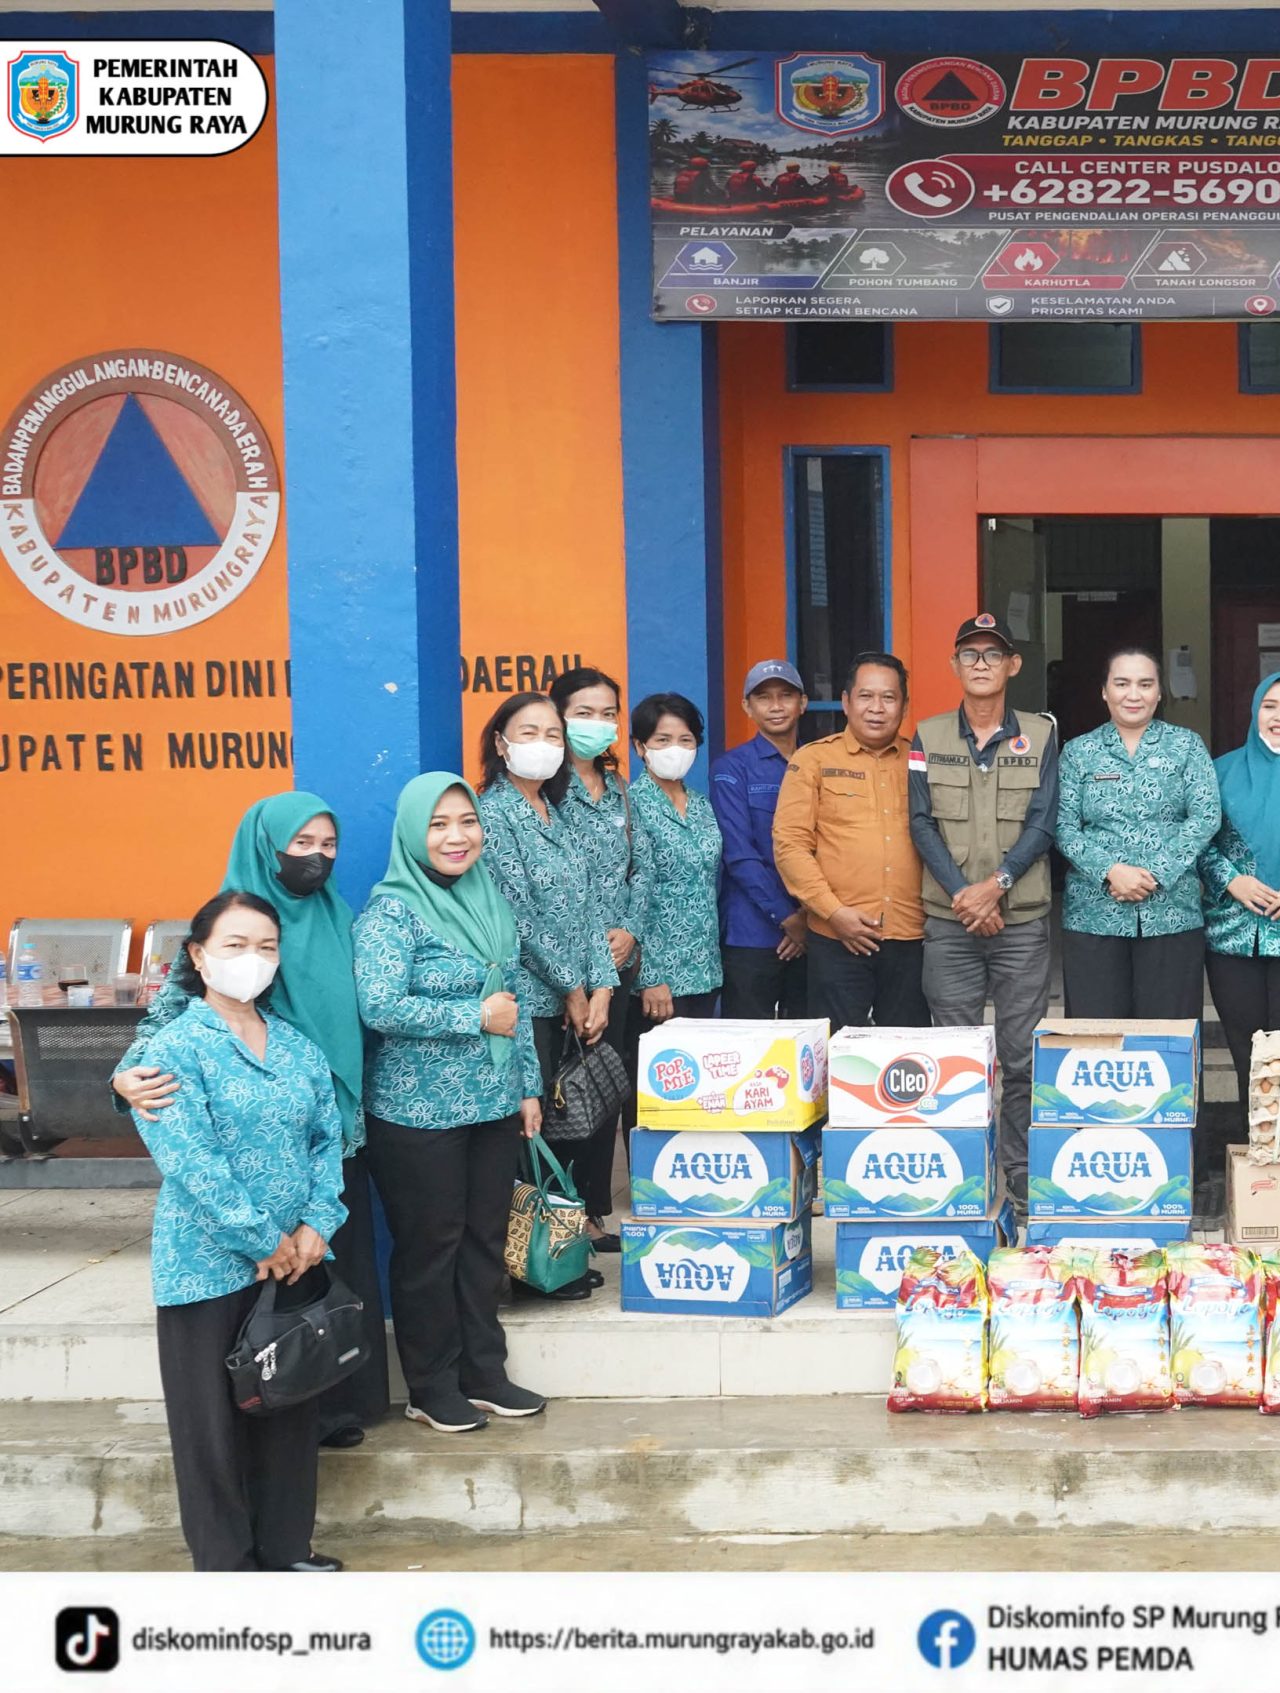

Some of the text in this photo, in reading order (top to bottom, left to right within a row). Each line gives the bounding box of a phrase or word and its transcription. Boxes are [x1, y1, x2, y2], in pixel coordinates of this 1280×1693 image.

[1007, 115, 1150, 130] KABUPATEN
[1155, 115, 1259, 130] MURUNG
[1001, 134, 1093, 147] TANGGAP
[1113, 134, 1204, 147] TANGKAS
[1014, 160, 1074, 175] CALL
[1080, 160, 1170, 175] CENTER
[988, 211, 1031, 222] PUSAT
[1034, 211, 1139, 222] PENGENDALIAN
[1142, 211, 1199, 222] OPERASI
[679, 226, 775, 237] PELAYANAN
[713, 278, 760, 286] BANJIR
[849, 278, 959, 287] POHON TUMBANG
[1024, 278, 1091, 287] KARHUTLA
[1155, 278, 1257, 287] TANAH LONGSOR
[735, 296, 862, 305] LAPORKAN SEGERA
[1031, 297, 1177, 305] KESELAMATAN ANDA
[735, 307, 918, 316] SETIAP KEJADIAN BENCANA
[1031, 307, 1143, 316] PRIORITAS KAMI
[95, 546, 187, 586] BPBD
[205, 660, 276, 698] DINI
[167, 732, 293, 770] MURUN
[655, 1057, 684, 1081] POP
[1071, 1060, 1155, 1092] AQUA
[664, 1070, 695, 1091] MIE
[890, 1068, 926, 1093] Cleo
[745, 1087, 769, 1098] KARI
[744, 1099, 774, 1110] AYAM
[669, 1152, 753, 1184] AQUA
[862, 1152, 948, 1184] AQUA
[1068, 1151, 1152, 1183] AQUA
[655, 1258, 735, 1291] AQUA
